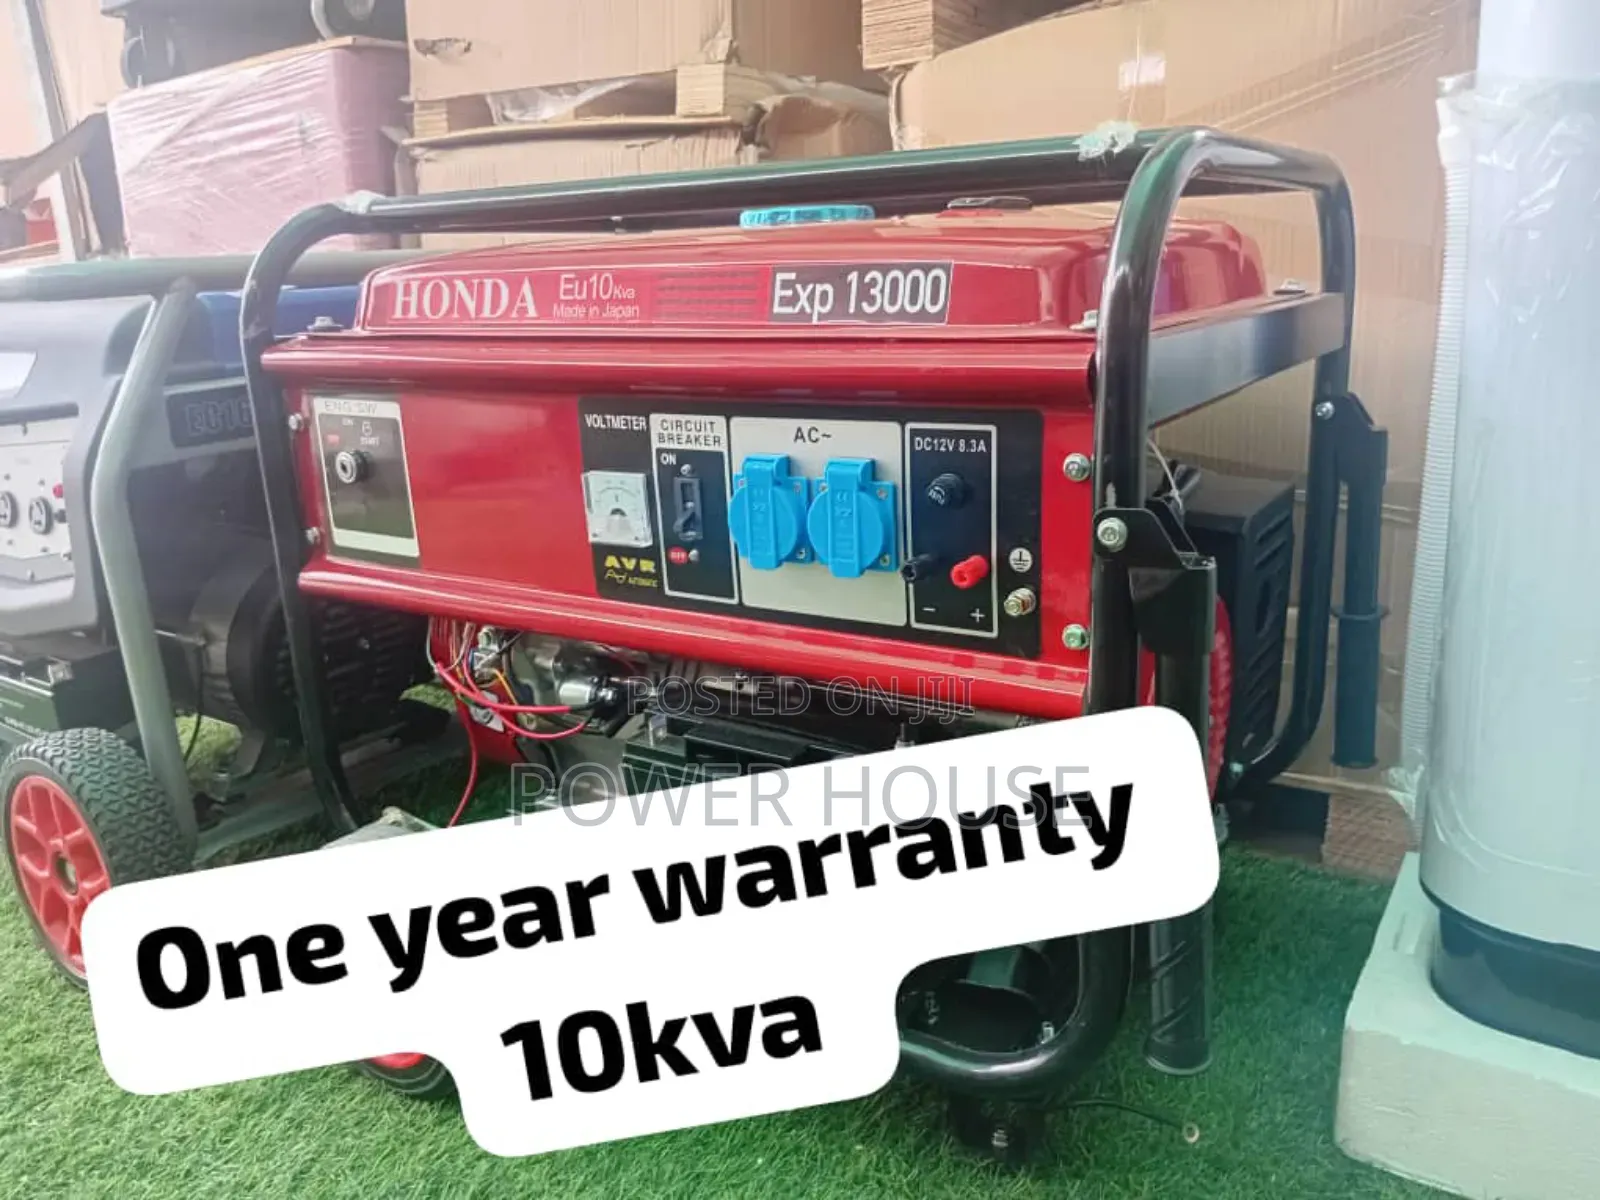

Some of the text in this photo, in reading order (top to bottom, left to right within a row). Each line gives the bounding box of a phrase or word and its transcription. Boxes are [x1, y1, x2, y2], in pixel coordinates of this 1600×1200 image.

[391, 275, 540, 320] HONDA
[772, 268, 947, 325] Exp 13000
[553, 303, 640, 321] Made in Japan
[584, 413, 648, 432] VOLTMETER
[660, 418, 717, 434] CIRCUIT
[658, 432, 722, 447] BREAKER
[914, 436, 988, 453] DC12V 8.3A
[660, 452, 677, 466] ON
[604, 555, 656, 574] AVR
